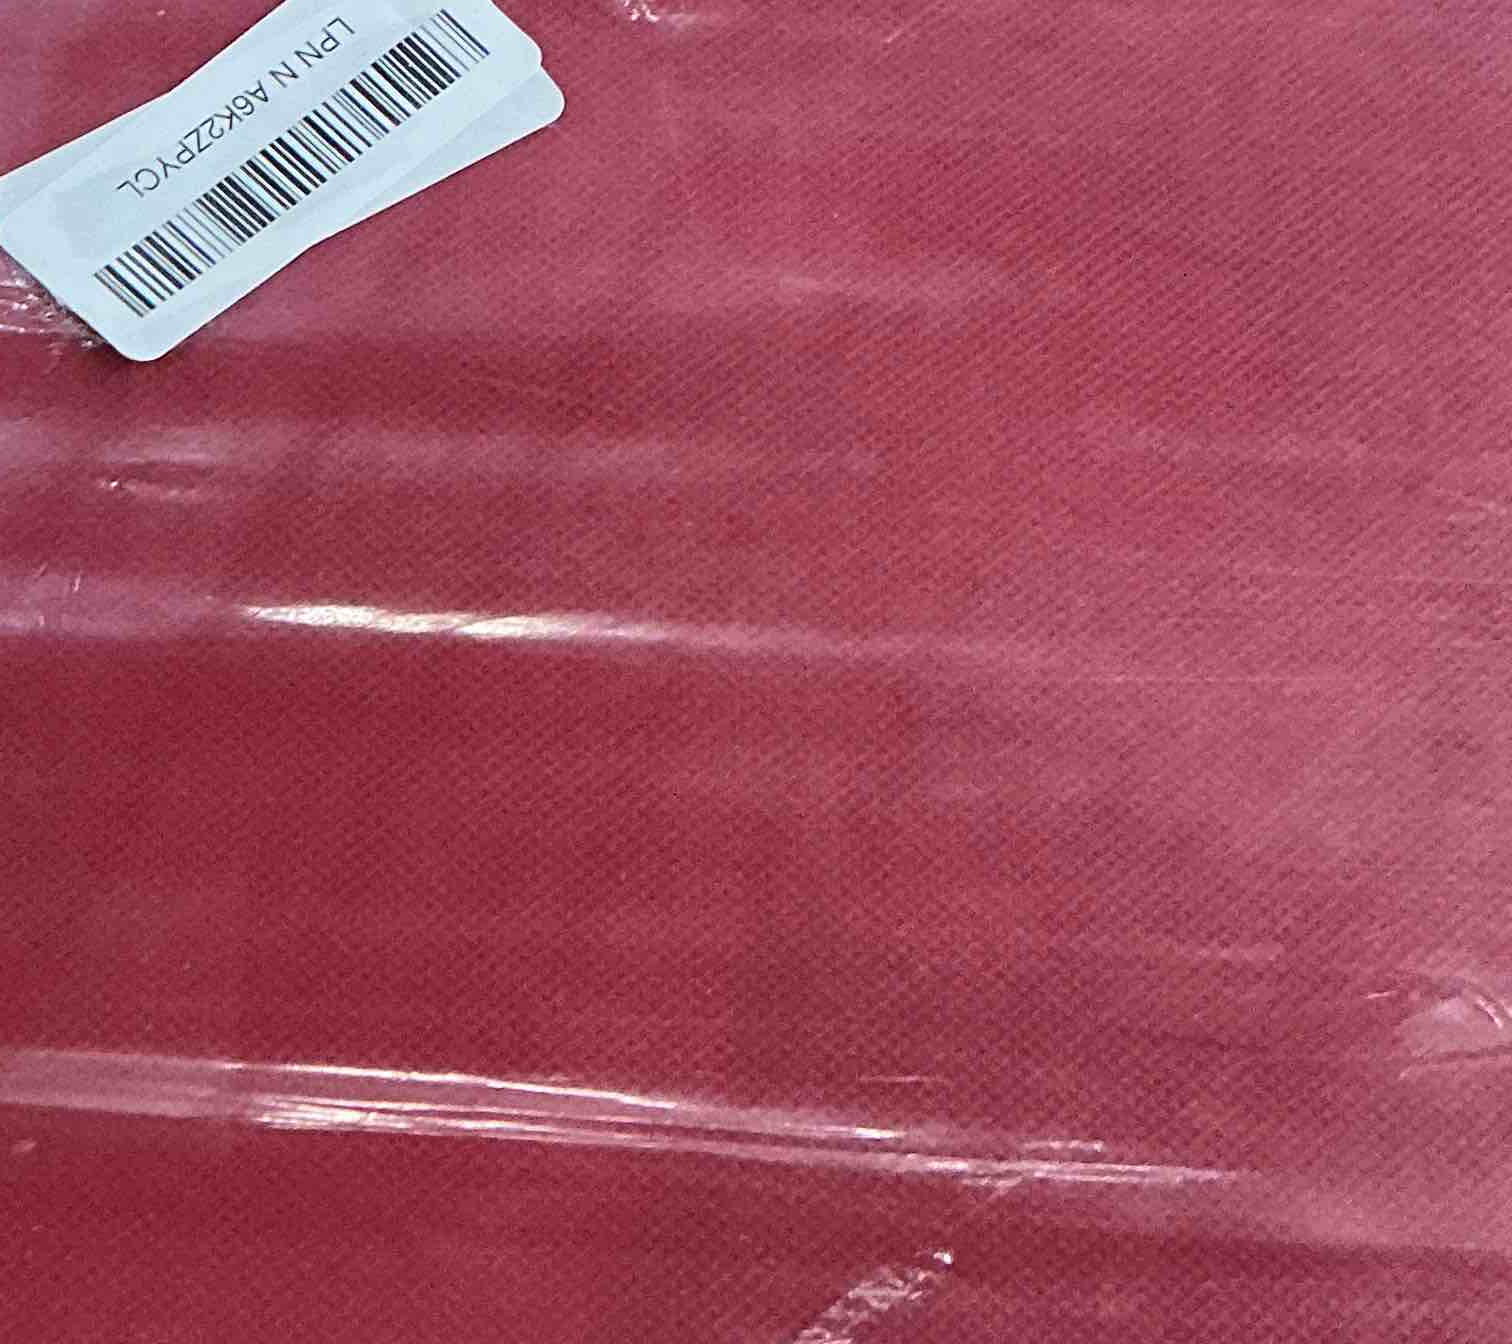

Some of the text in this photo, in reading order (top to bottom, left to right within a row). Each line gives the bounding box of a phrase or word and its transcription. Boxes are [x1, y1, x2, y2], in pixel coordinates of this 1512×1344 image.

[115, 16, 356, 198] LPN N A6K2ZPYCL
